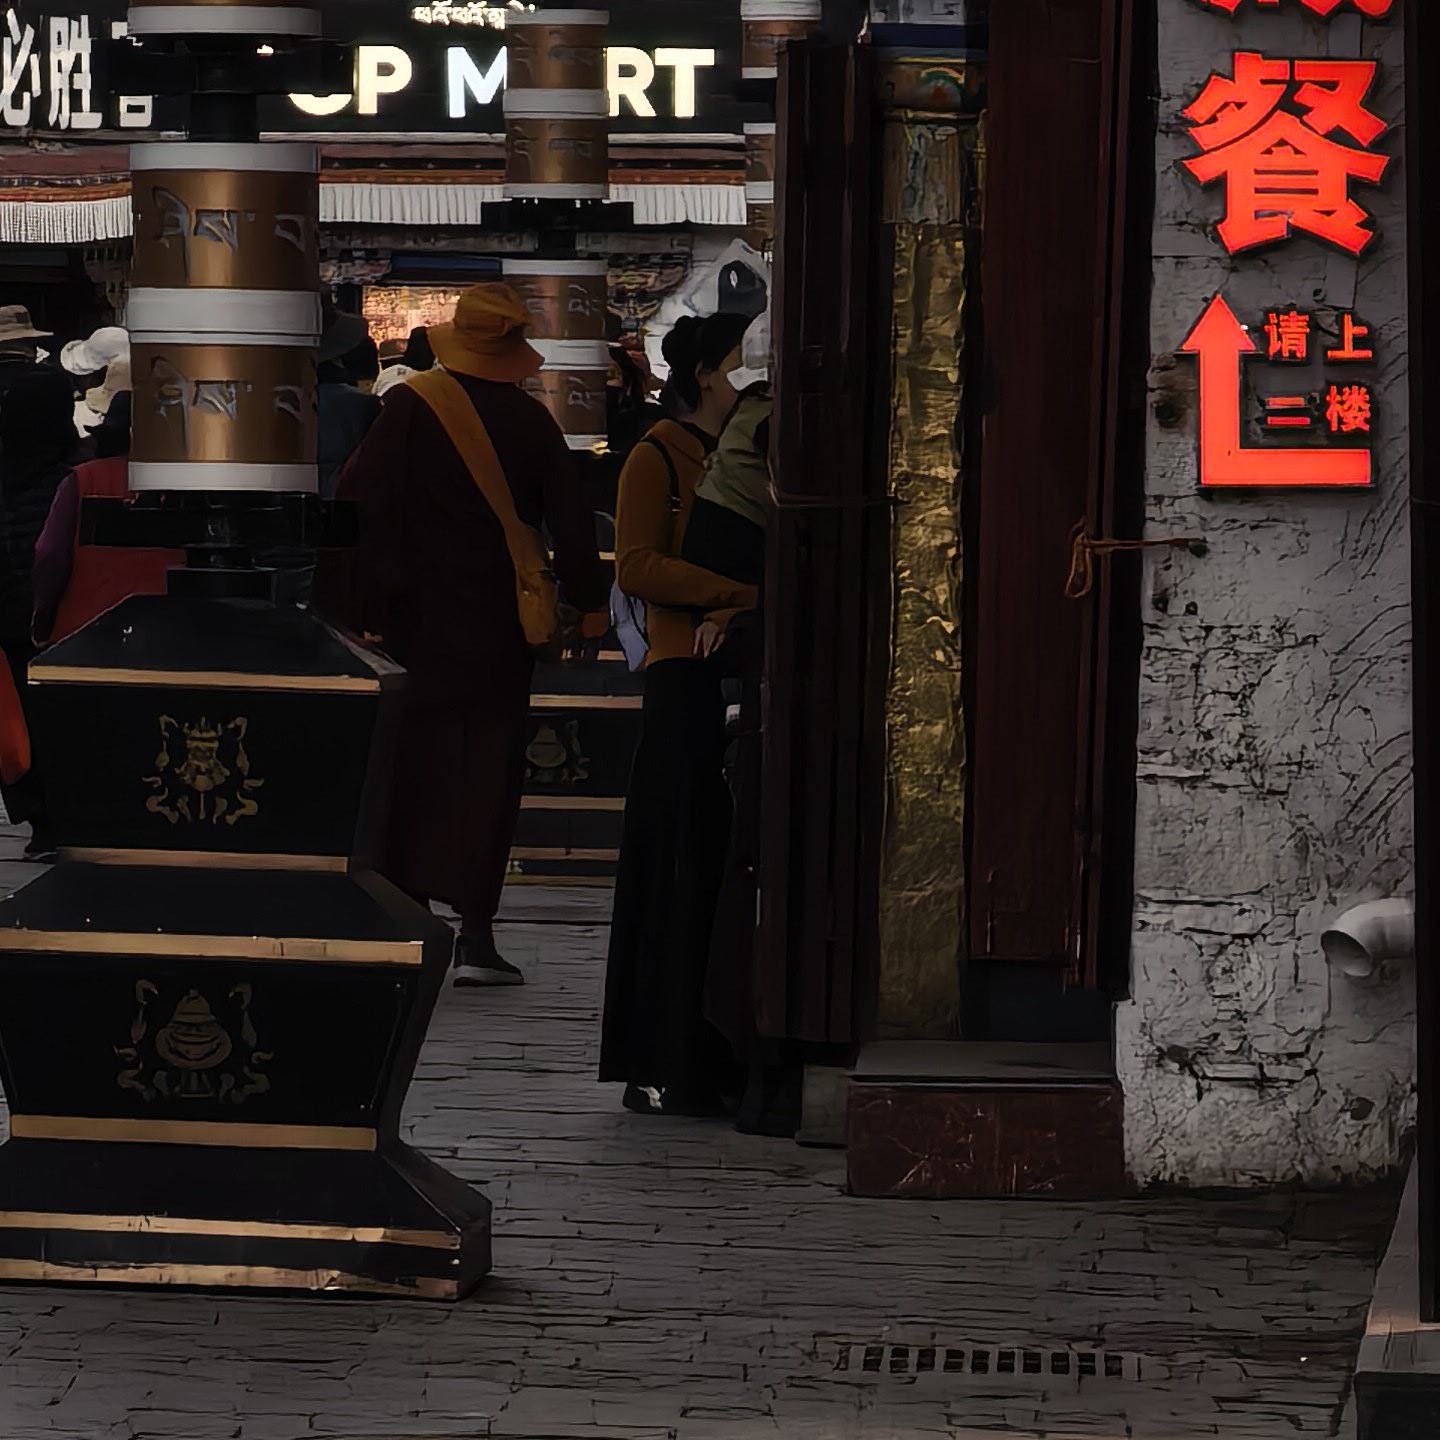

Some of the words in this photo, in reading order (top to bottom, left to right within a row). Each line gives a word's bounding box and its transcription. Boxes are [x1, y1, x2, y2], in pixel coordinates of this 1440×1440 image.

[447, 45, 716, 118] MRT
[1264, 311, 1373, 361] 请上
[1265, 385, 1370, 432] 二楼
